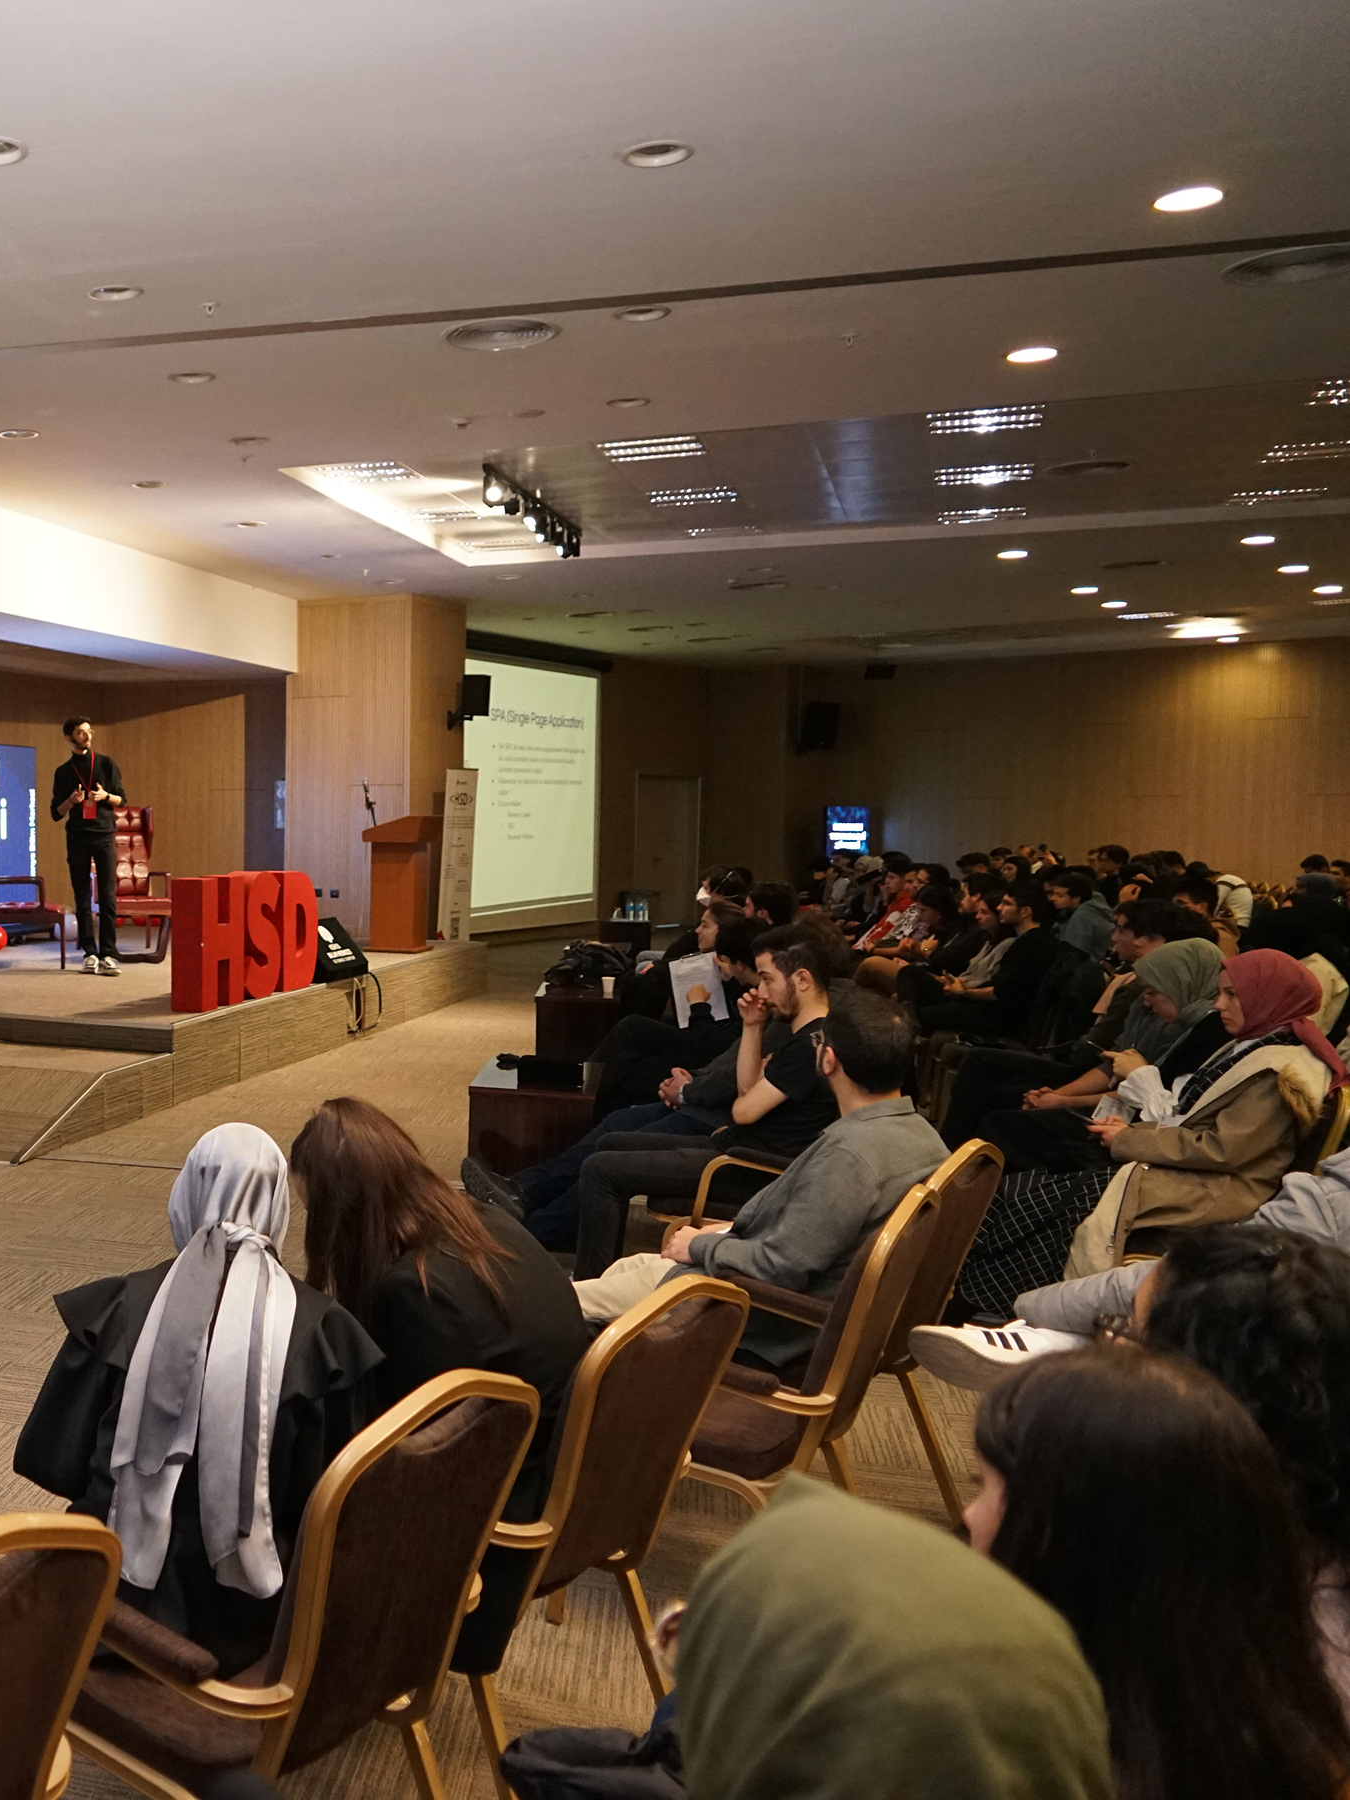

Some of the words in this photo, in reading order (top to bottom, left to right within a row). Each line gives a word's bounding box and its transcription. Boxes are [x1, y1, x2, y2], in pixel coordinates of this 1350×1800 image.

[490, 707, 506, 722] SPA
[531, 712, 548, 729] Page
[198, 870, 319, 1012] HSD
